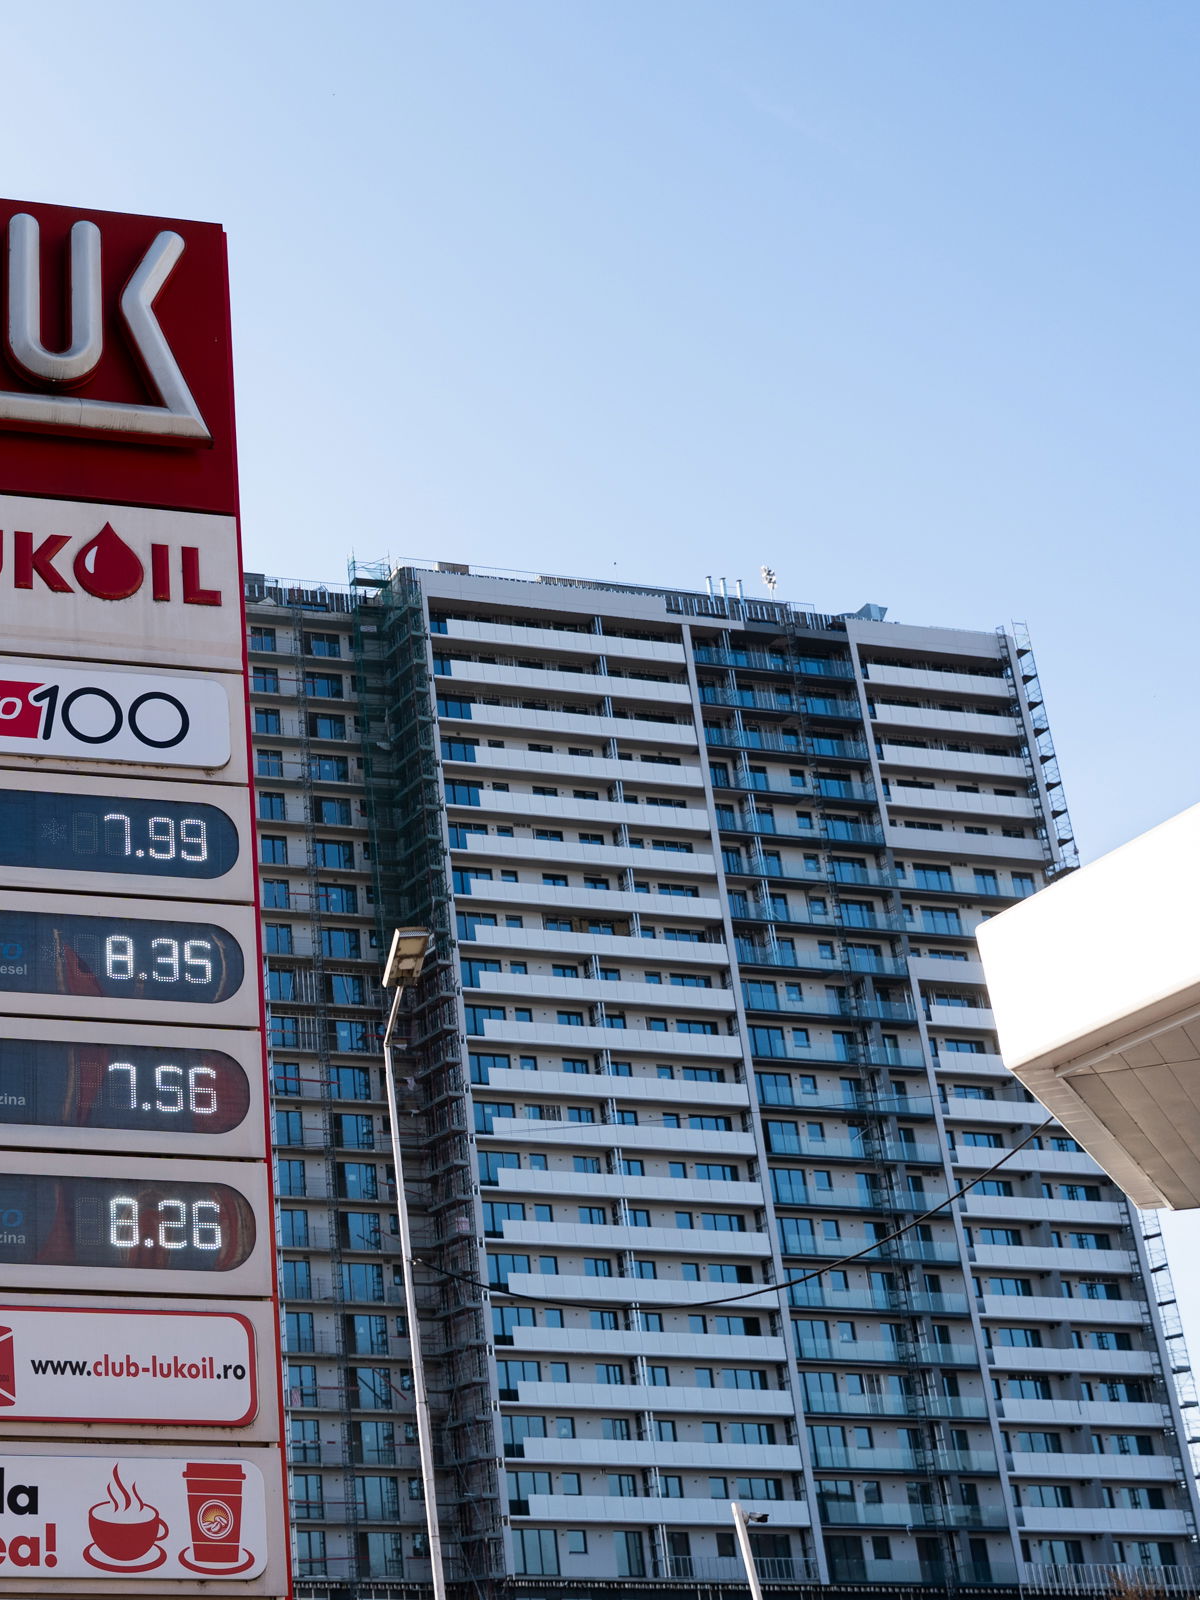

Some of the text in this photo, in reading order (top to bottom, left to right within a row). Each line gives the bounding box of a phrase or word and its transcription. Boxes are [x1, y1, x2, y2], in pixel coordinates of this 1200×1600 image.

[33, 684, 190, 749] 100
[104, 813, 208, 862] 7.99
[106, 935, 212, 984] 8.35
[108, 1062, 217, 1114] 7.56
[110, 1196, 222, 1250] 8.26
[31, 1353, 246, 1380] www.club-lukoil.ro
